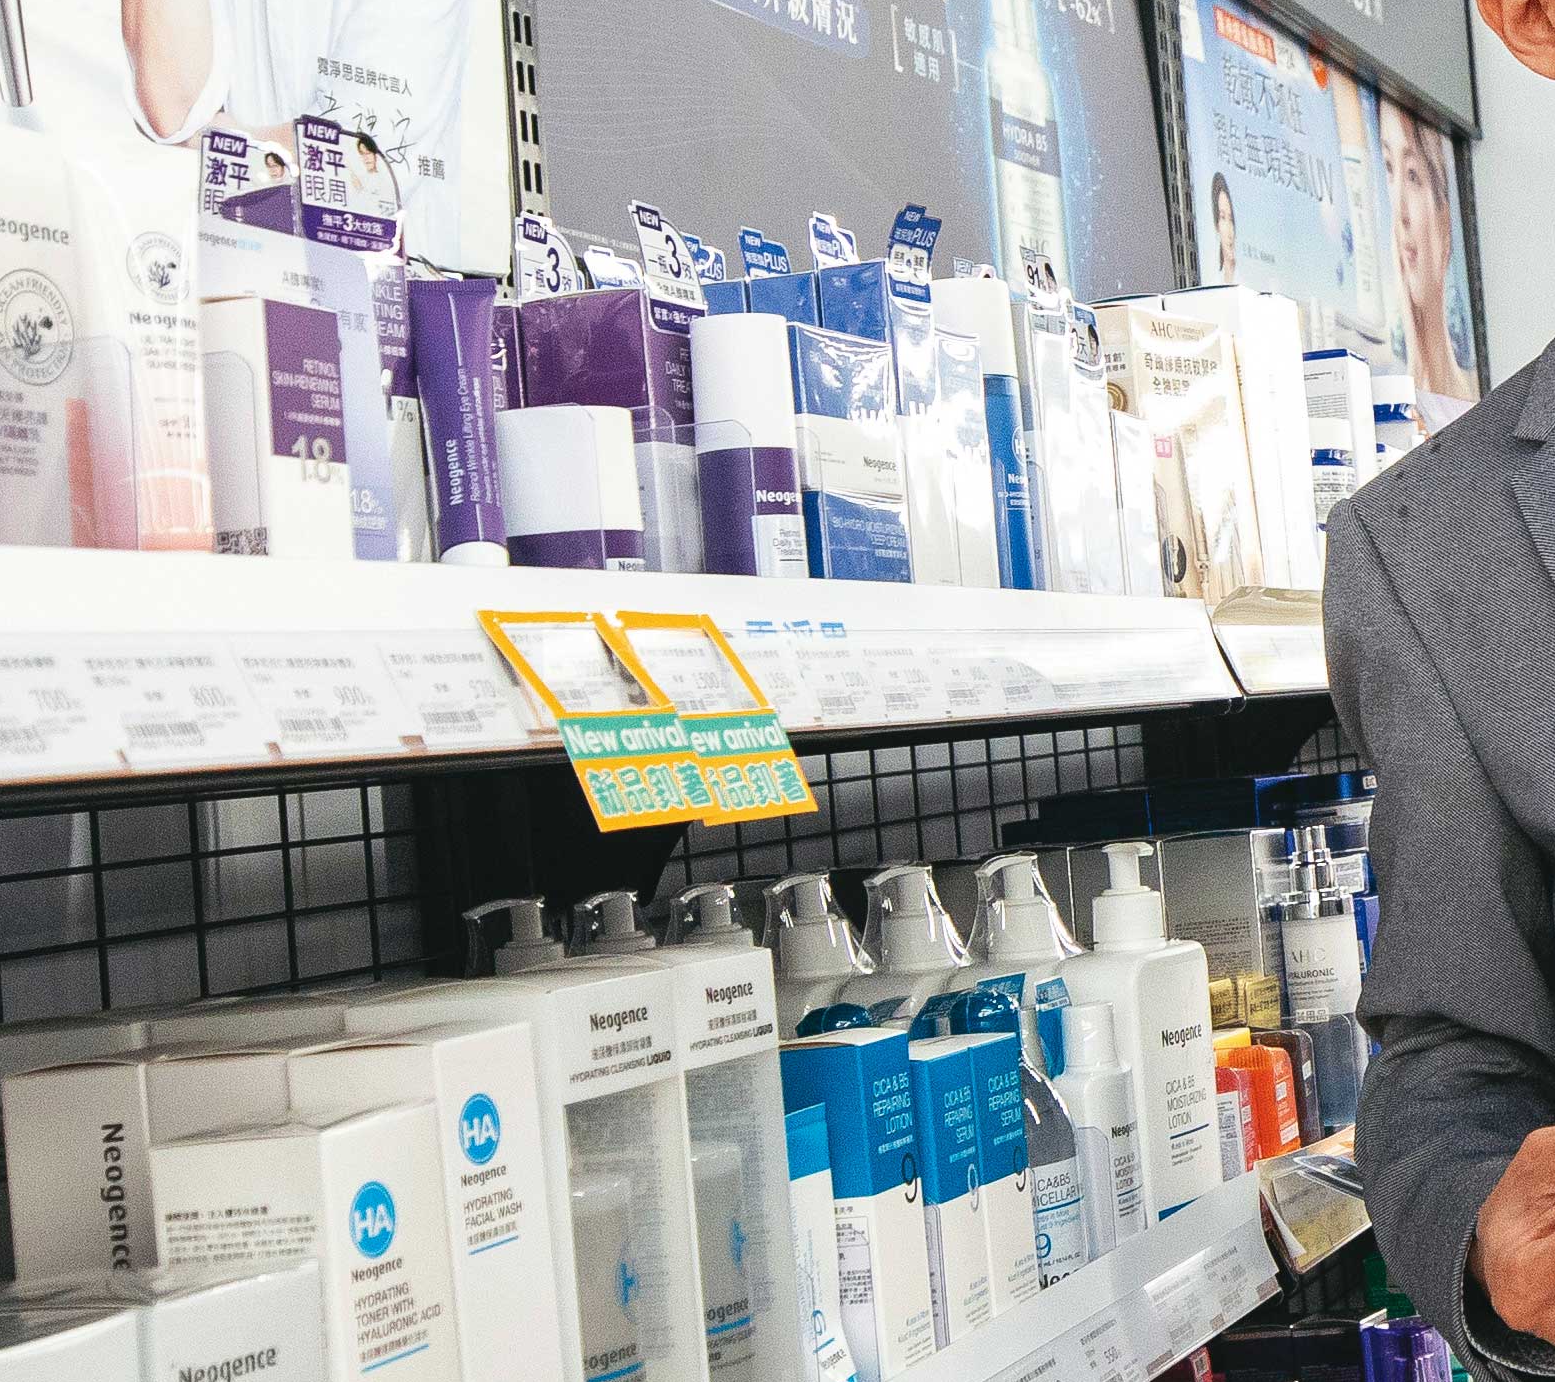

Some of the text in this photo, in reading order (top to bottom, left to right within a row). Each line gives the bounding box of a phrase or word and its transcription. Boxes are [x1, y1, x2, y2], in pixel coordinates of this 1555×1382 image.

[317, 57, 413, 98] 霓淨思品牌代言人
[212, 136, 243, 154] NEW
[306, 123, 338, 141] NEW
[206, 157, 250, 190] 激平
[303, 143, 346, 176] 激平
[417, 155, 446, 180] 推薦
[305, 174, 348, 208] 眼周
[525, 224, 546, 240] NEW
[1151, 321, 1175, 339] AHC
[448, 438, 465, 507] Neogence
[862, 456, 898, 474] Neogence
[564, 719, 687, 755] New arrival
[691, 718, 788, 753] ew arrival
[705, 981, 754, 1005] Neogence
[589, 1005, 649, 1032] Neogence
[1160, 1021, 1203, 1049] Neogence
[461, 1113, 496, 1150] HA
[1167, 1111, 1193, 1130] LOTION
[460, 1164, 507, 1189] Neogence
[100, 1121, 132, 1274] Neogence
[463, 1187, 513, 1215] HYDRATING
[496, 1201, 524, 1222] WASH
[353, 1203, 394, 1243] HA
[350, 1256, 403, 1284] Neogence
[353, 1281, 409, 1313] HYDRATING
[354, 1296, 415, 1329] TONER WITH
[356, 1303, 442, 1345] HYALURONIC ACID
